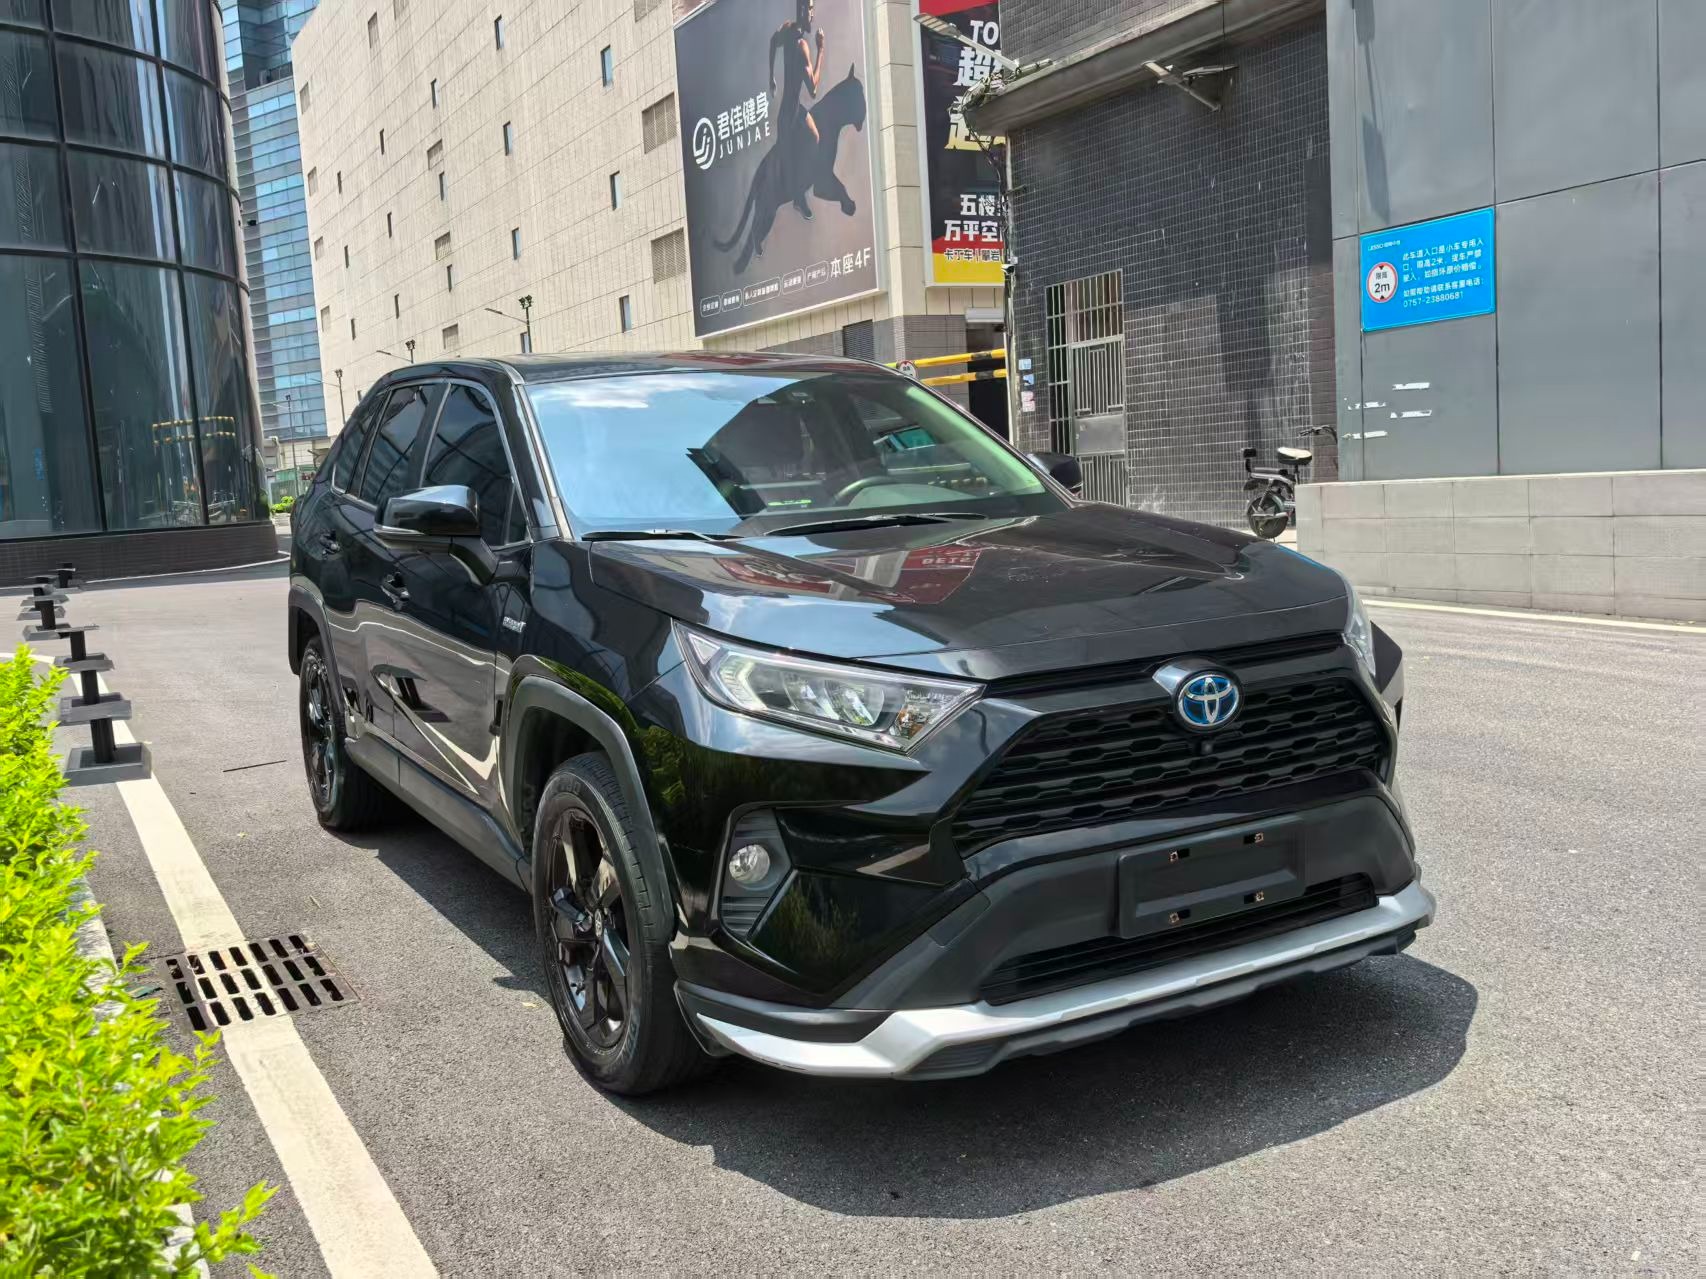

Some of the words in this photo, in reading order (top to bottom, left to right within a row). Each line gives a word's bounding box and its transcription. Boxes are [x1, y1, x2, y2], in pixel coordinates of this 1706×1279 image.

[970, 20, 999, 45] TO
[717, 92, 769, 140] 君佳健身
[719, 121, 771, 159] JUNJAE
[960, 194, 1001, 216] 五楼
[944, 220, 1003, 242] 万平空
[1374, 283, 1390, 293] 2m
